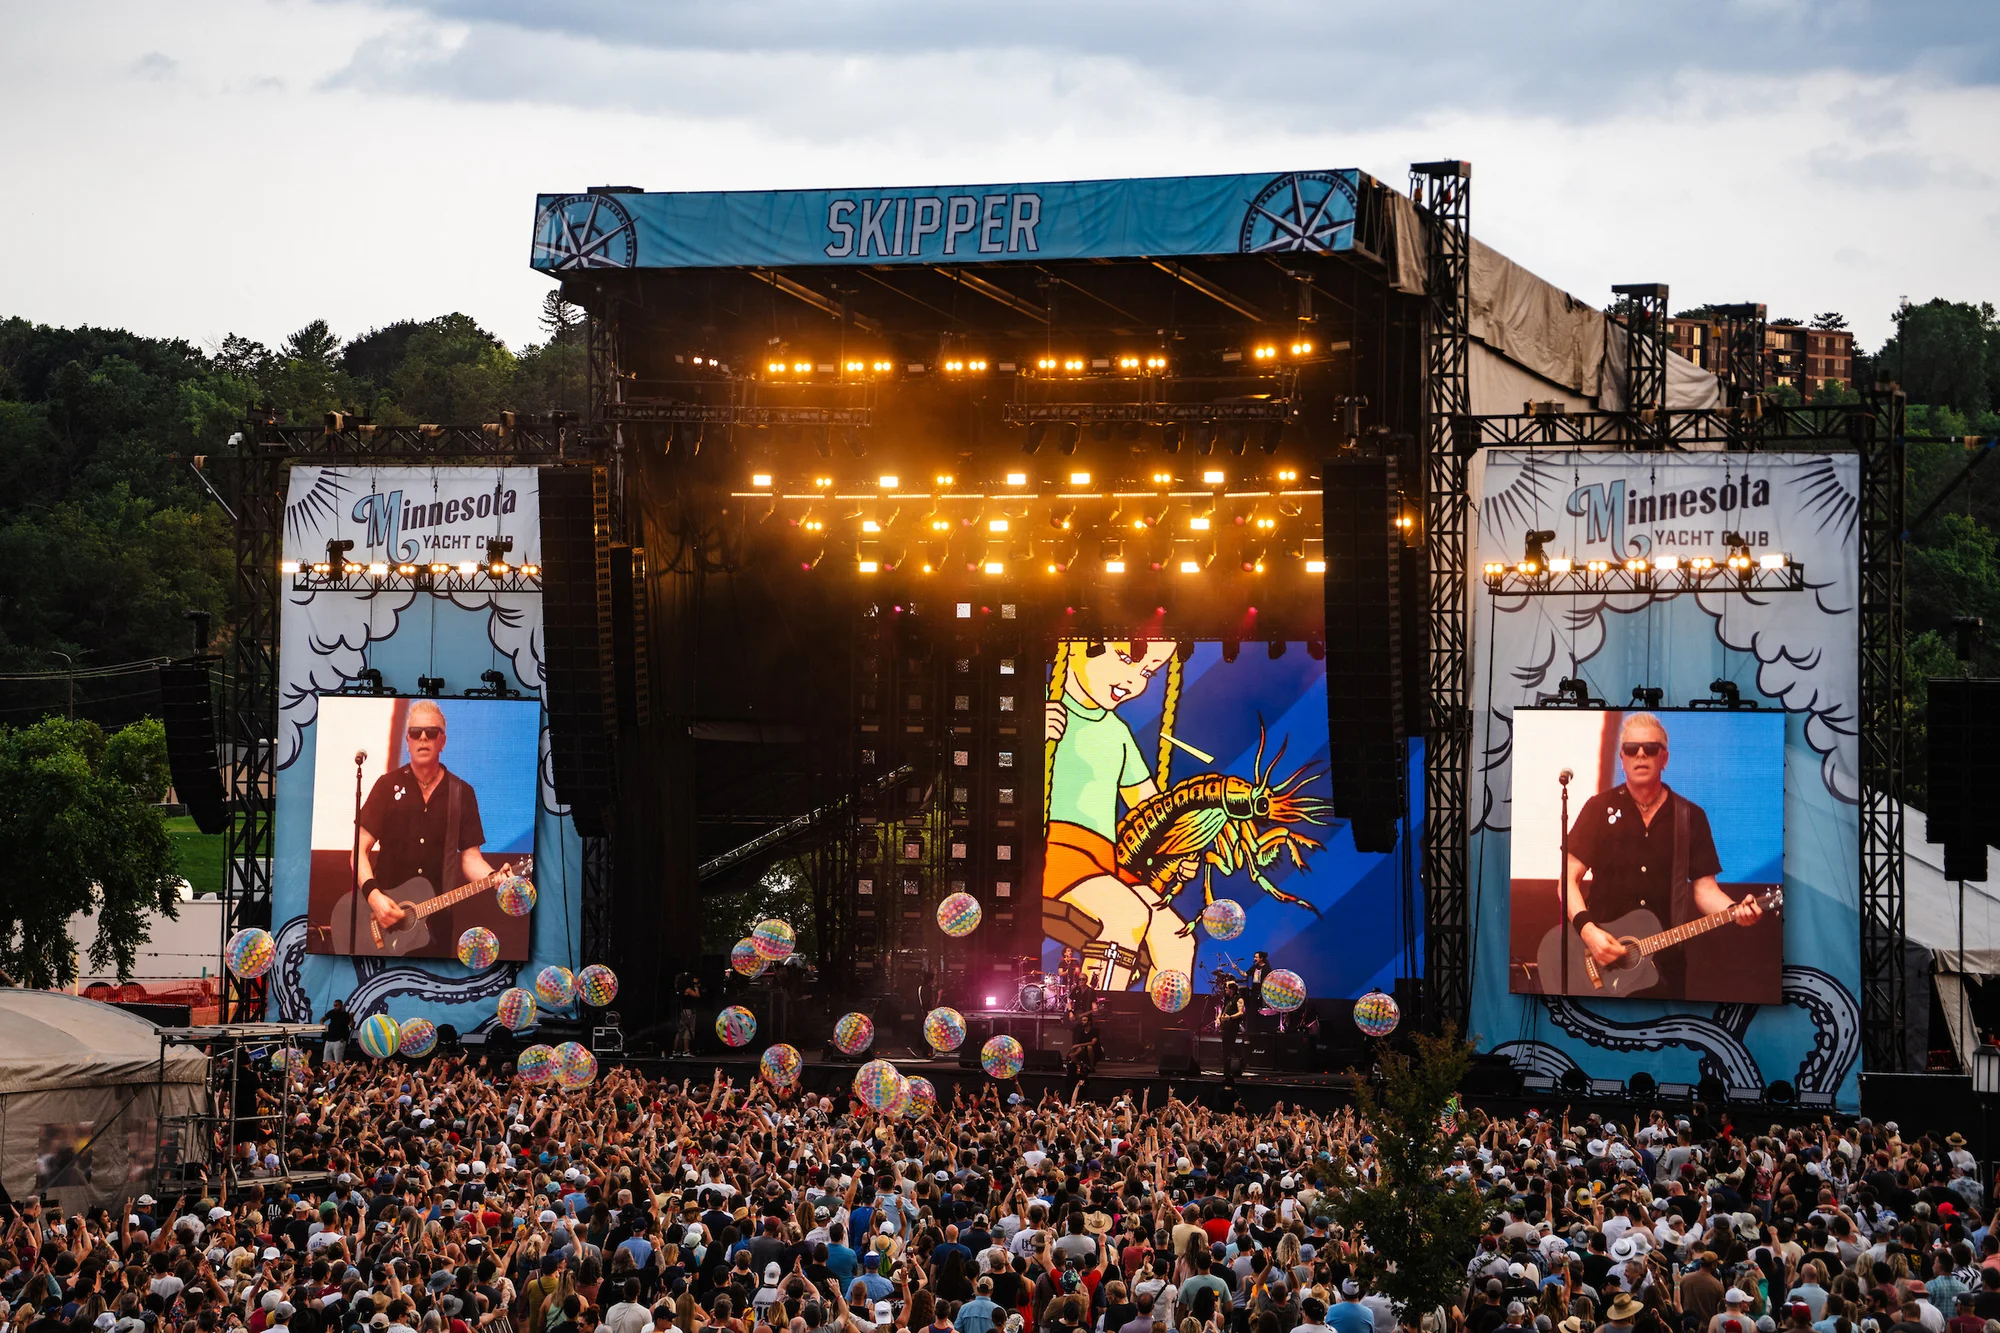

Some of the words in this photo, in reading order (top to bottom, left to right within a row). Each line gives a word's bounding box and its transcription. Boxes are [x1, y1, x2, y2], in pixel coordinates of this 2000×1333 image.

[824, 193, 1041, 259] SKIPPER
[351, 486, 517, 565] Minnesota
[423, 535, 471, 549] YACHT
[1566, 473, 1770, 563] Minnesota
[1655, 530, 1714, 546] YACHT
[1722, 530, 1769, 547] CUB
